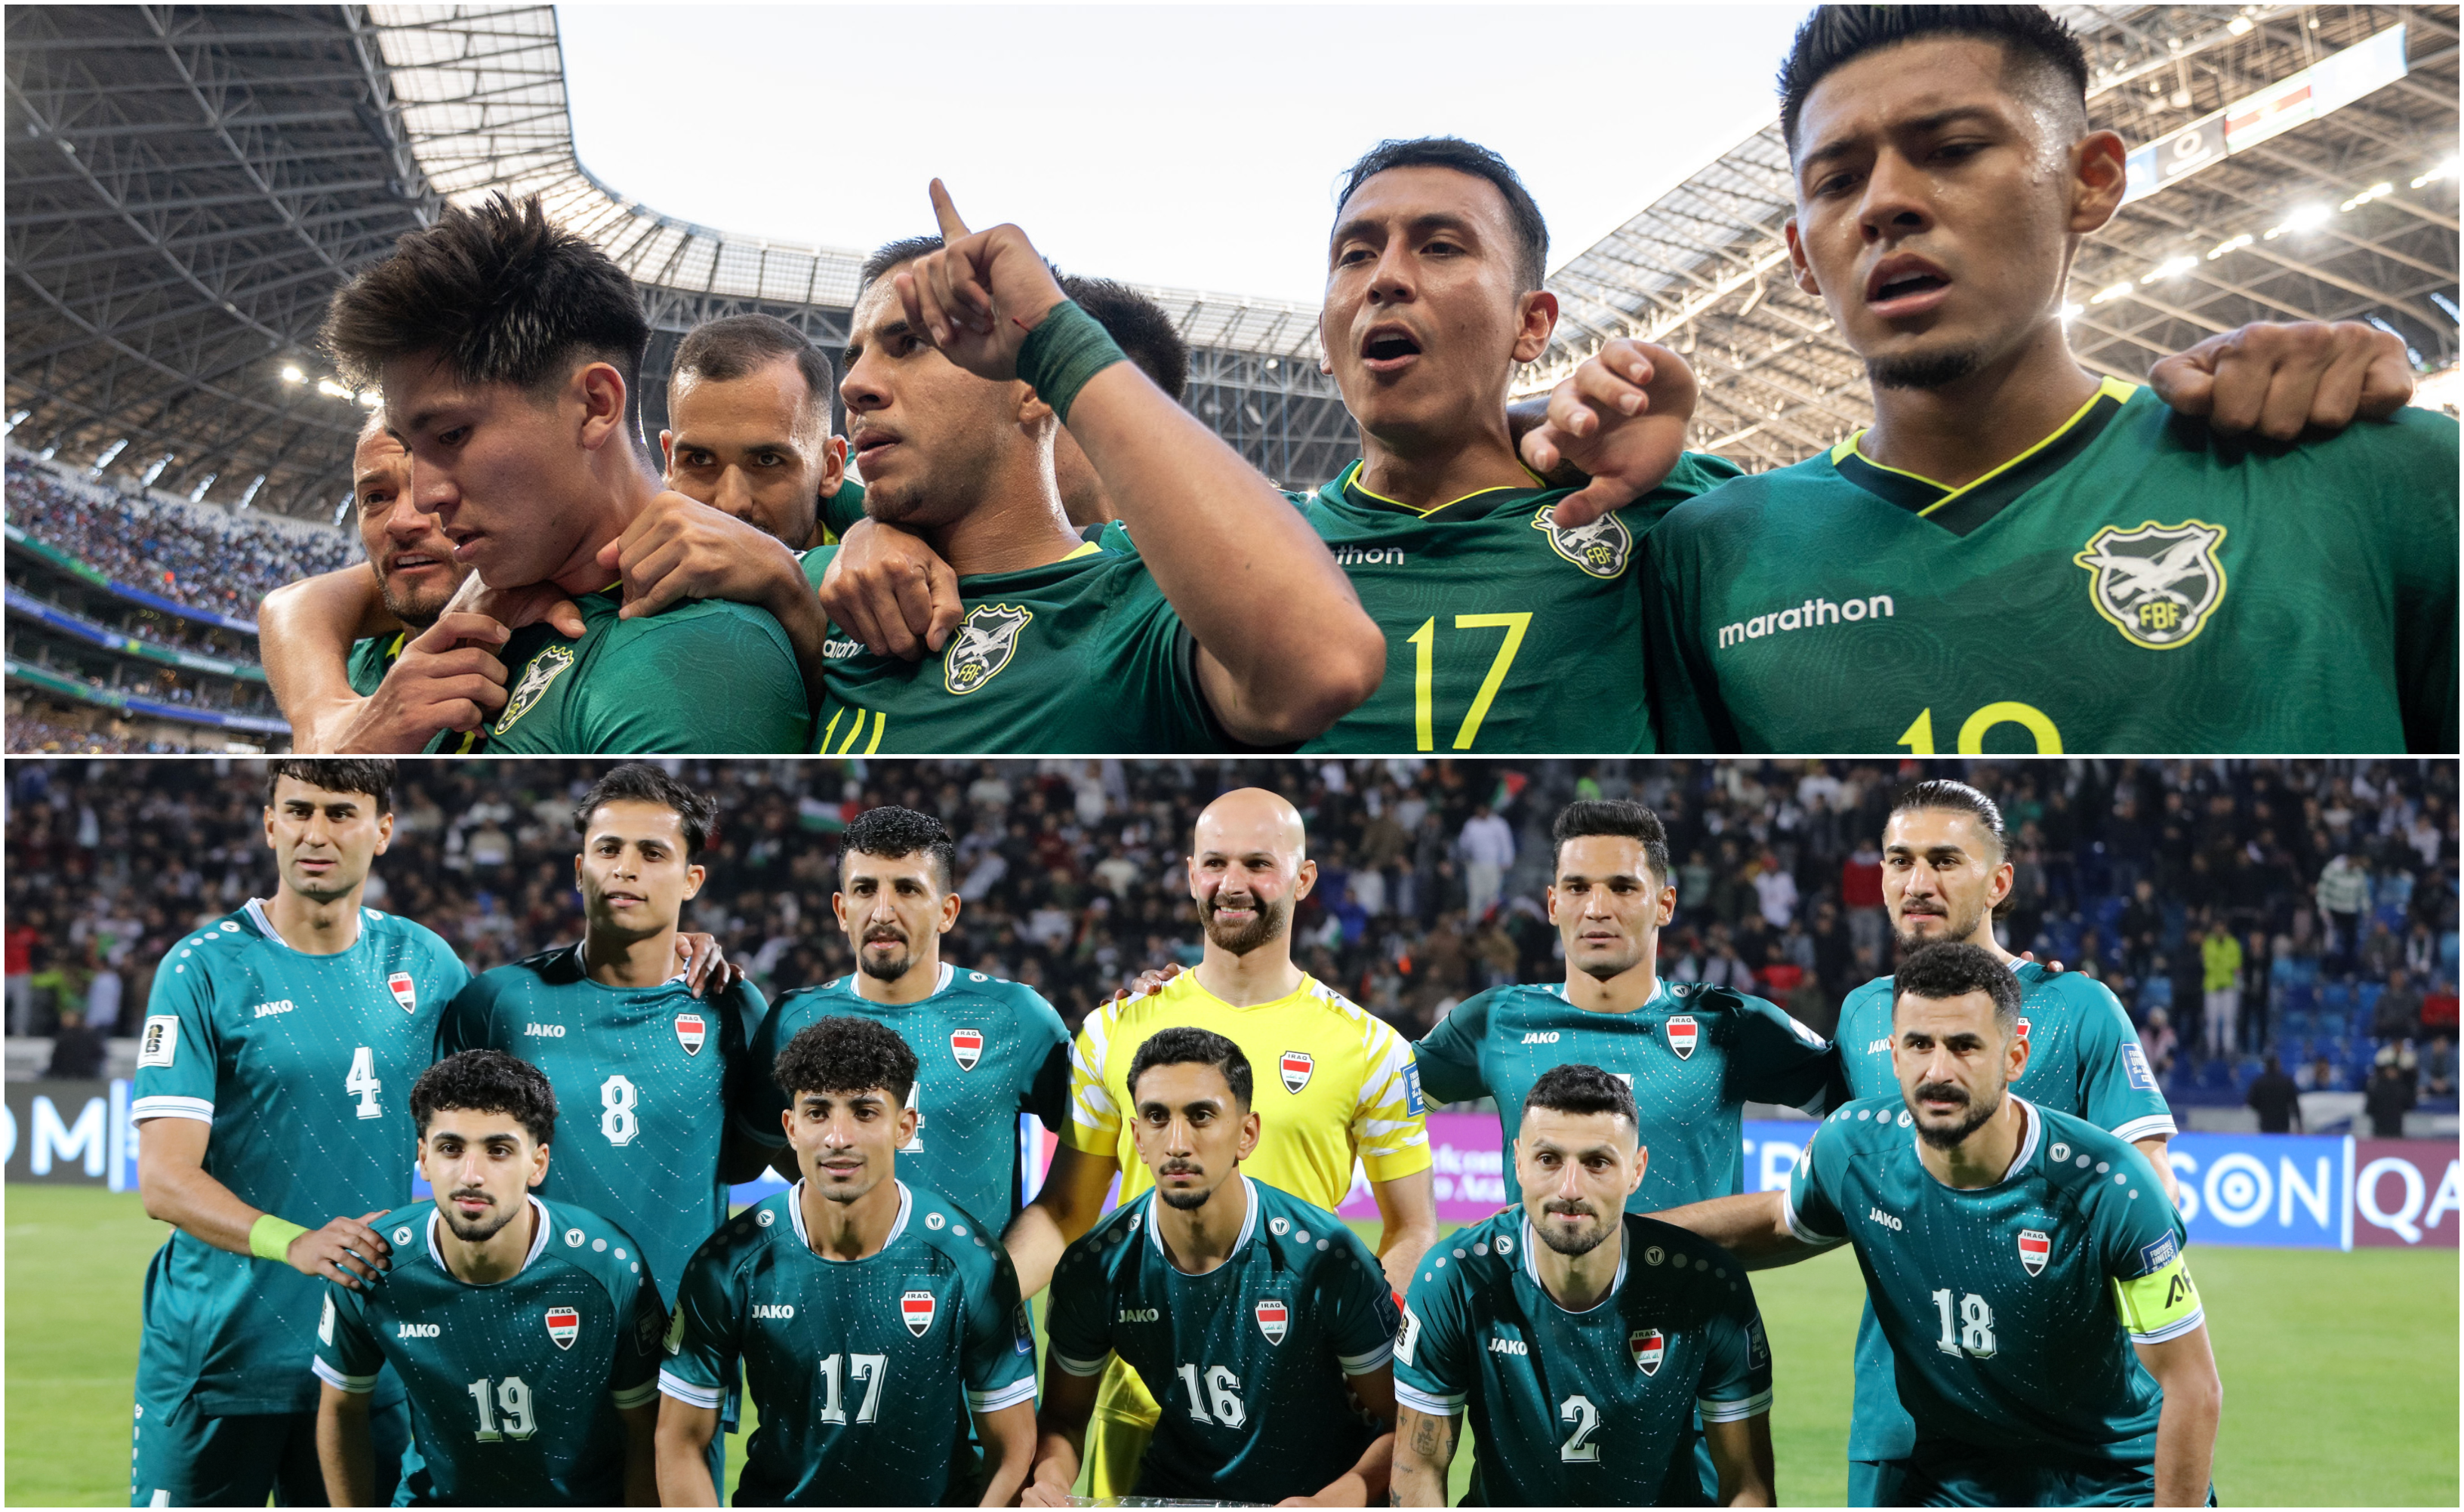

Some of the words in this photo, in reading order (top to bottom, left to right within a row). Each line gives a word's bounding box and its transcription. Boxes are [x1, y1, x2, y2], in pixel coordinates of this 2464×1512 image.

[1586, 547, 1611, 565] FBF
[1719, 595, 1894, 649] marathon
[2139, 602, 2179, 629] FBF
[957, 664, 982, 682] FBF
[1406, 611, 1533, 751] 17
[254, 999, 294, 1018] JAKO
[524, 1023, 566, 1038] JAKO
[1520, 1031, 1560, 1044] JAKO
[346, 1046, 383, 1119] 4
[600, 1075, 640, 1147] 8
[1870, 1207, 1902, 1231] JAKO
[2024, 1231, 2044, 1239] IRAQ
[752, 1304, 795, 1319] JAKO
[1119, 1308, 1159, 1323] JAKO
[397, 1324, 441, 1338] JAKO
[1932, 1288, 1997, 1360] 18
[1488, 1338, 1528, 1356] JAKO
[820, 1353, 889, 1426] 17
[1176, 1363, 1246, 1429] 16
[468, 1376, 538, 1443] 19
[1560, 1394, 1600, 1463] 2
